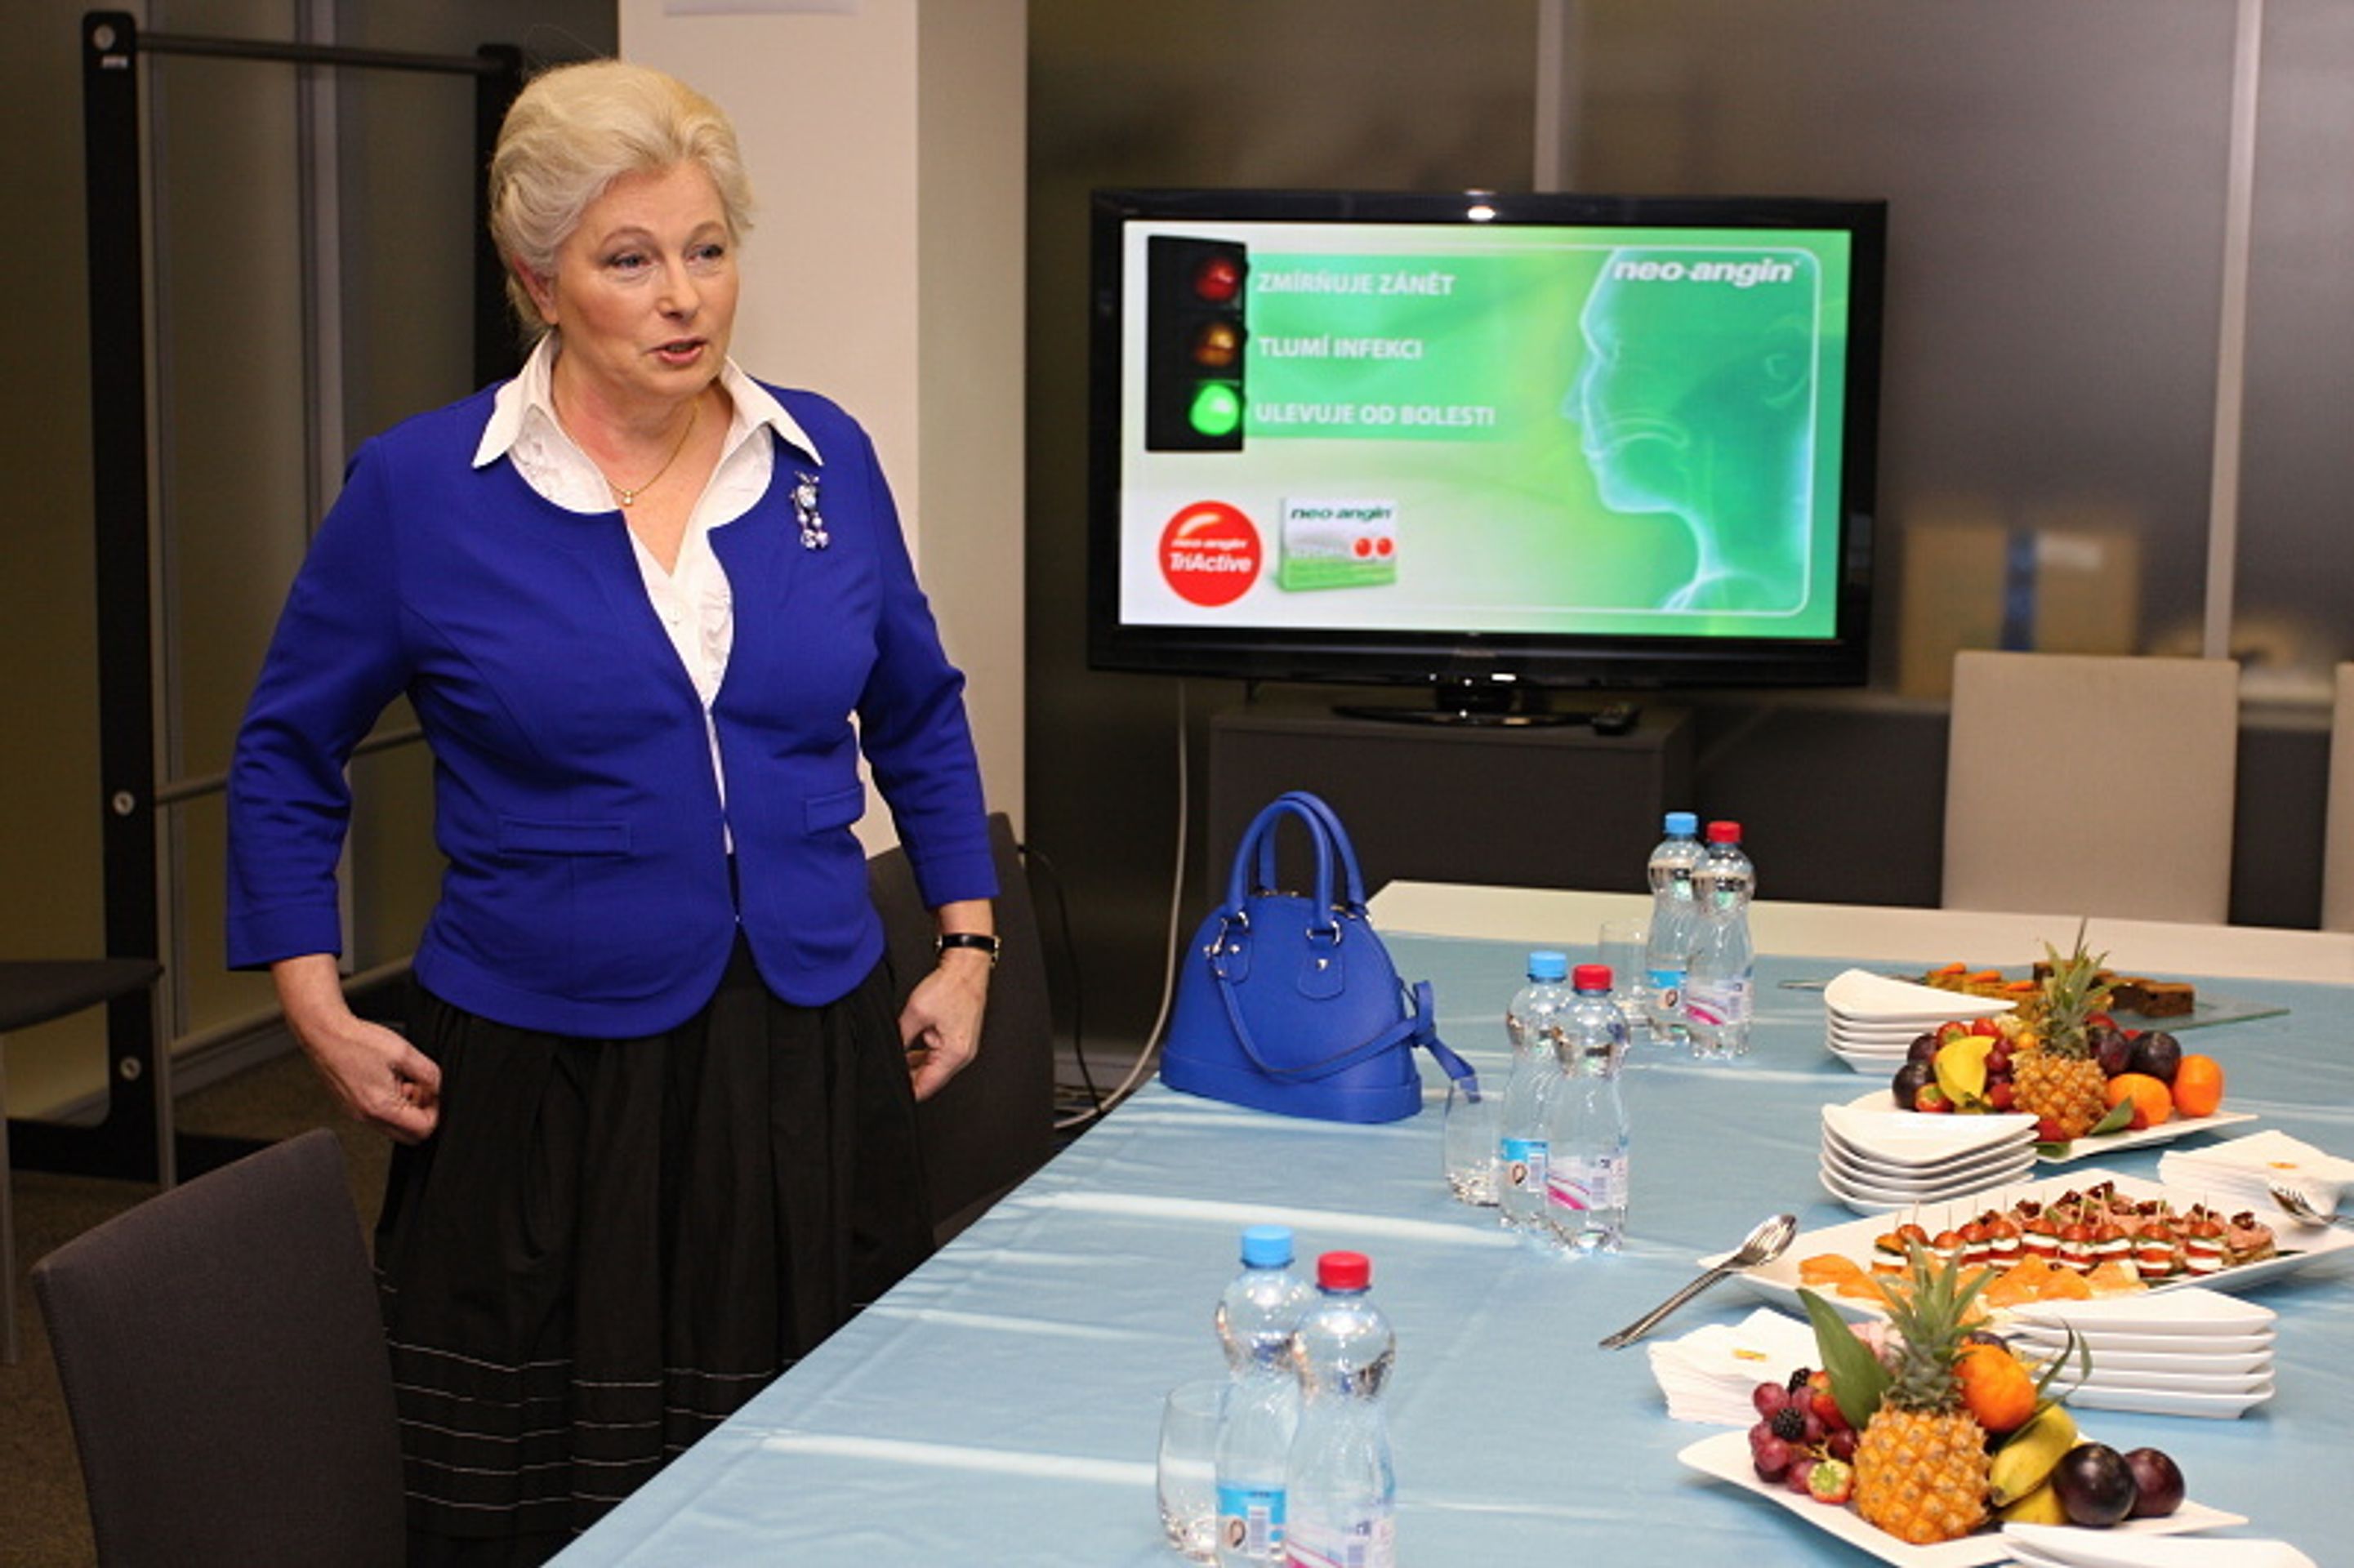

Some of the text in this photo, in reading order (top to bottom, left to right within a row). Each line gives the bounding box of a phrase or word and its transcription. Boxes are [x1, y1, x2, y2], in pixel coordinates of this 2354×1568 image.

[1257, 270, 1456, 295] ZMÍRŇUJE ZÁNĚT
[1258, 334, 1423, 359] TLUMÍ INFEKCI
[1255, 403, 1496, 426] ULEVUJE OD BOLESTI
[1170, 552, 1252, 573] TriActive
